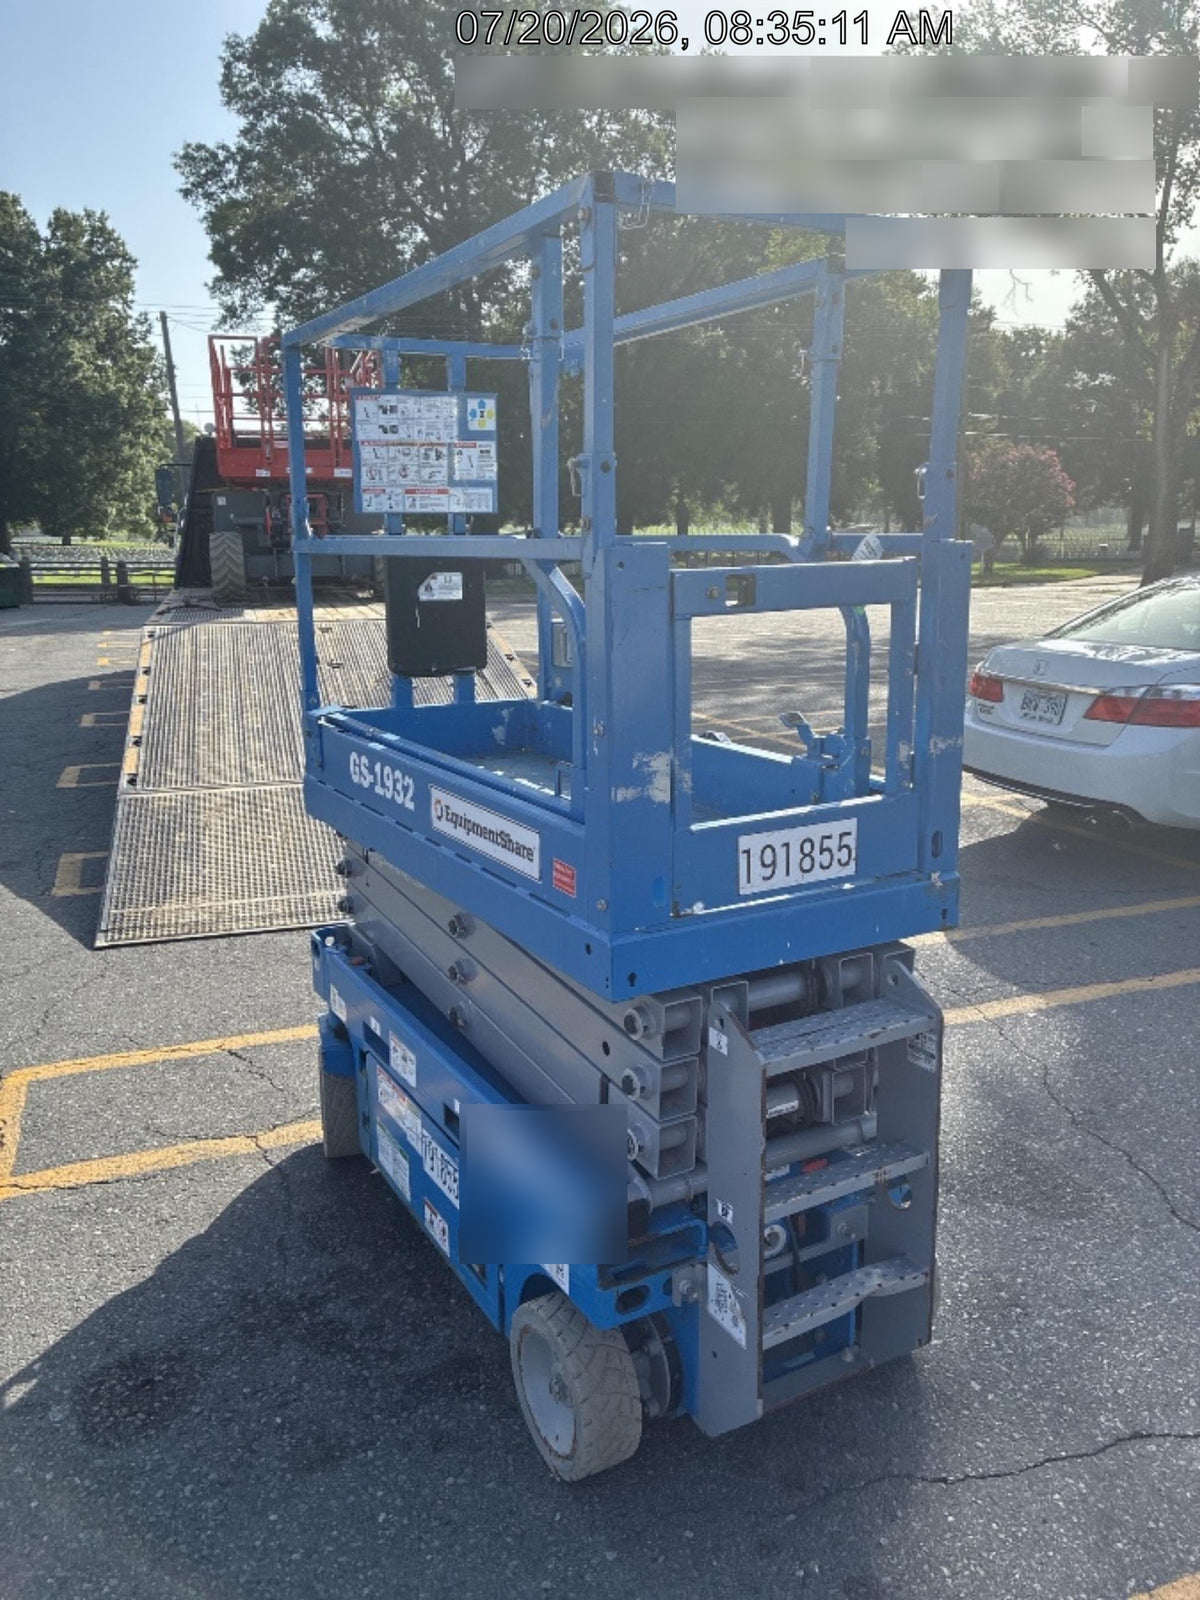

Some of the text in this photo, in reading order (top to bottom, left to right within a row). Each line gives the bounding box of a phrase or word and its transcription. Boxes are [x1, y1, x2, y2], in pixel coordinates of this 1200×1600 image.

[349, 751, 415, 811] GS-1932
[445, 804, 534, 863] EquipmentShare
[741, 831, 853, 884] 191855
